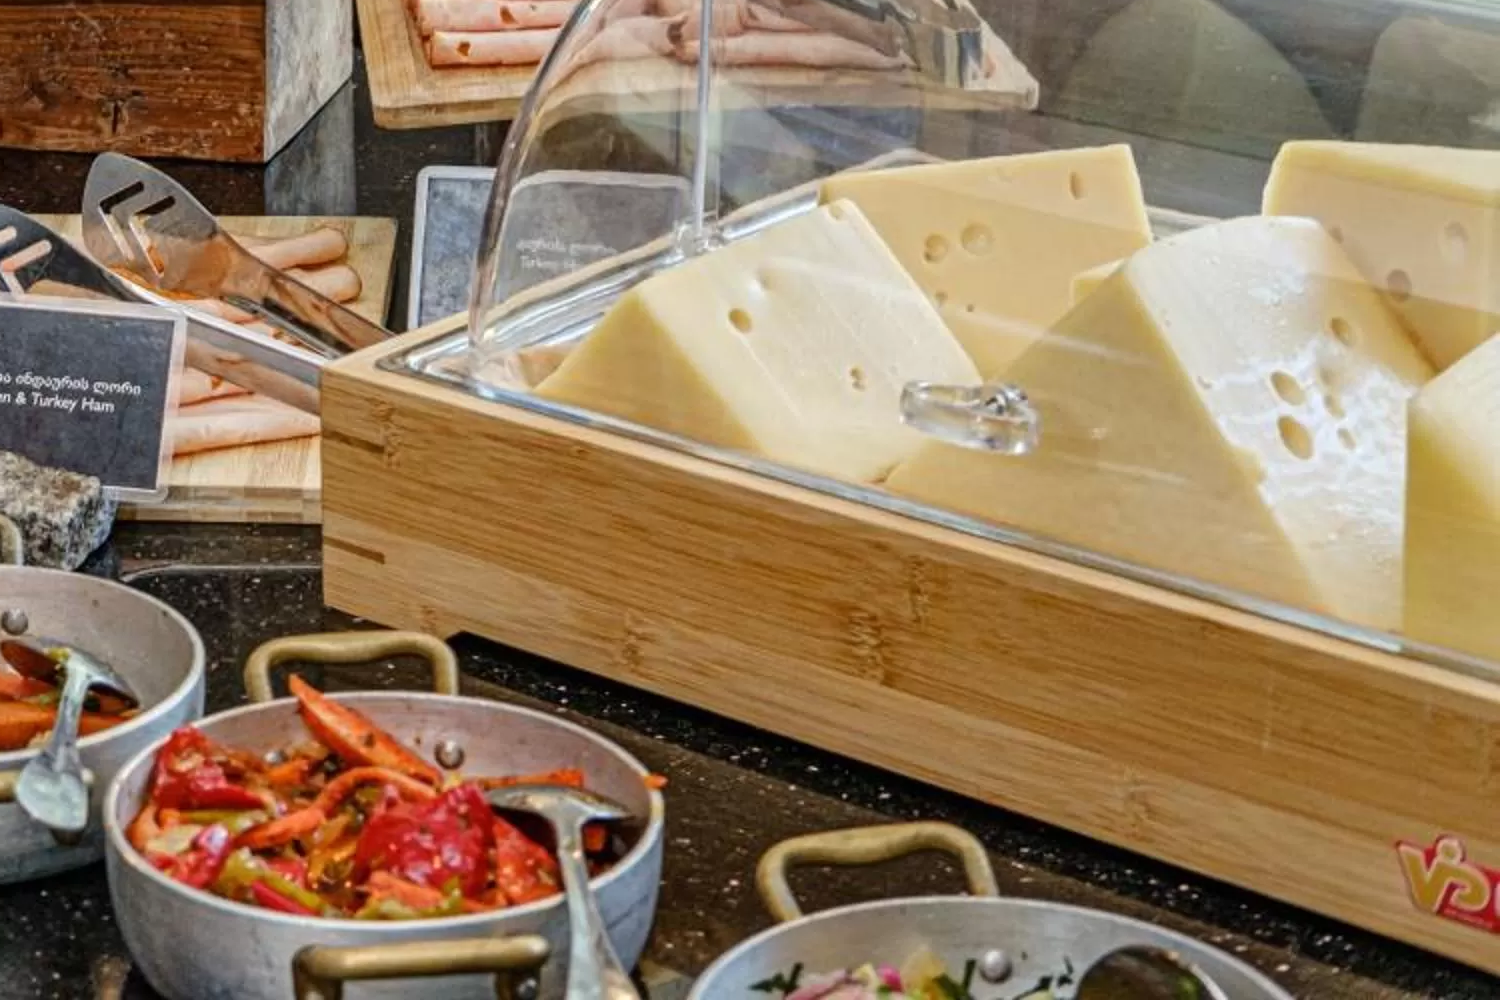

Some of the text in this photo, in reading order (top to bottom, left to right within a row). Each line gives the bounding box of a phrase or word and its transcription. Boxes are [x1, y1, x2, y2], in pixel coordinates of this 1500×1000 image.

[93, 381, 141, 396] ლორი
[15, 391, 27, 405] &
[32, 391, 77, 413] Turkey
[81, 397, 115, 413] Ham
